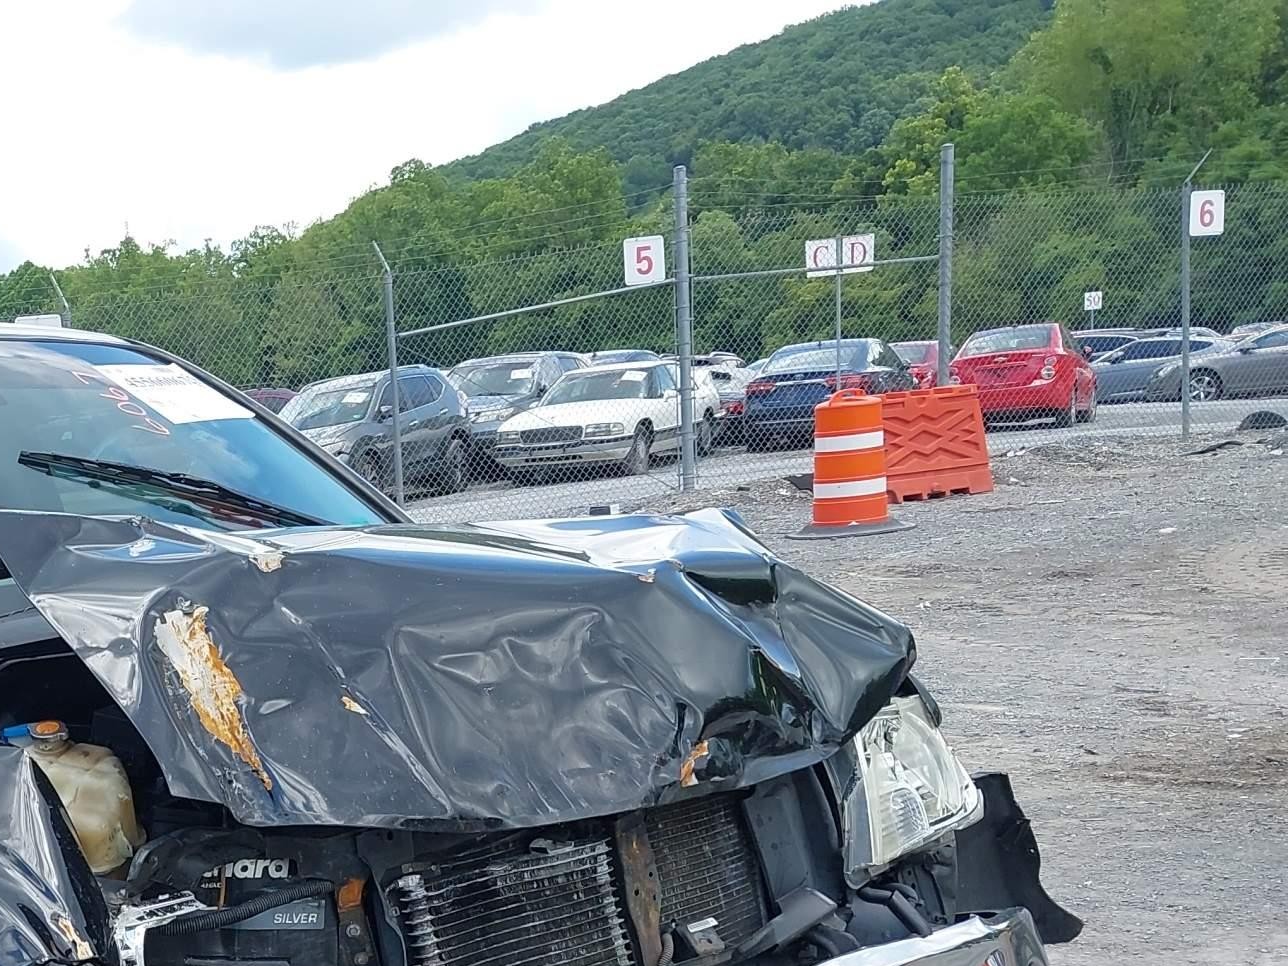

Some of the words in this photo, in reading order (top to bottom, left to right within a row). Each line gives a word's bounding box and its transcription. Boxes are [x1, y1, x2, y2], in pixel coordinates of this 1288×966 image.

[1199, 199, 1215, 228] 6
[635, 245, 654, 275] 5
[813, 244, 829, 268] C
[850, 241, 867, 265] D
[273, 913, 318, 924] SILVER
